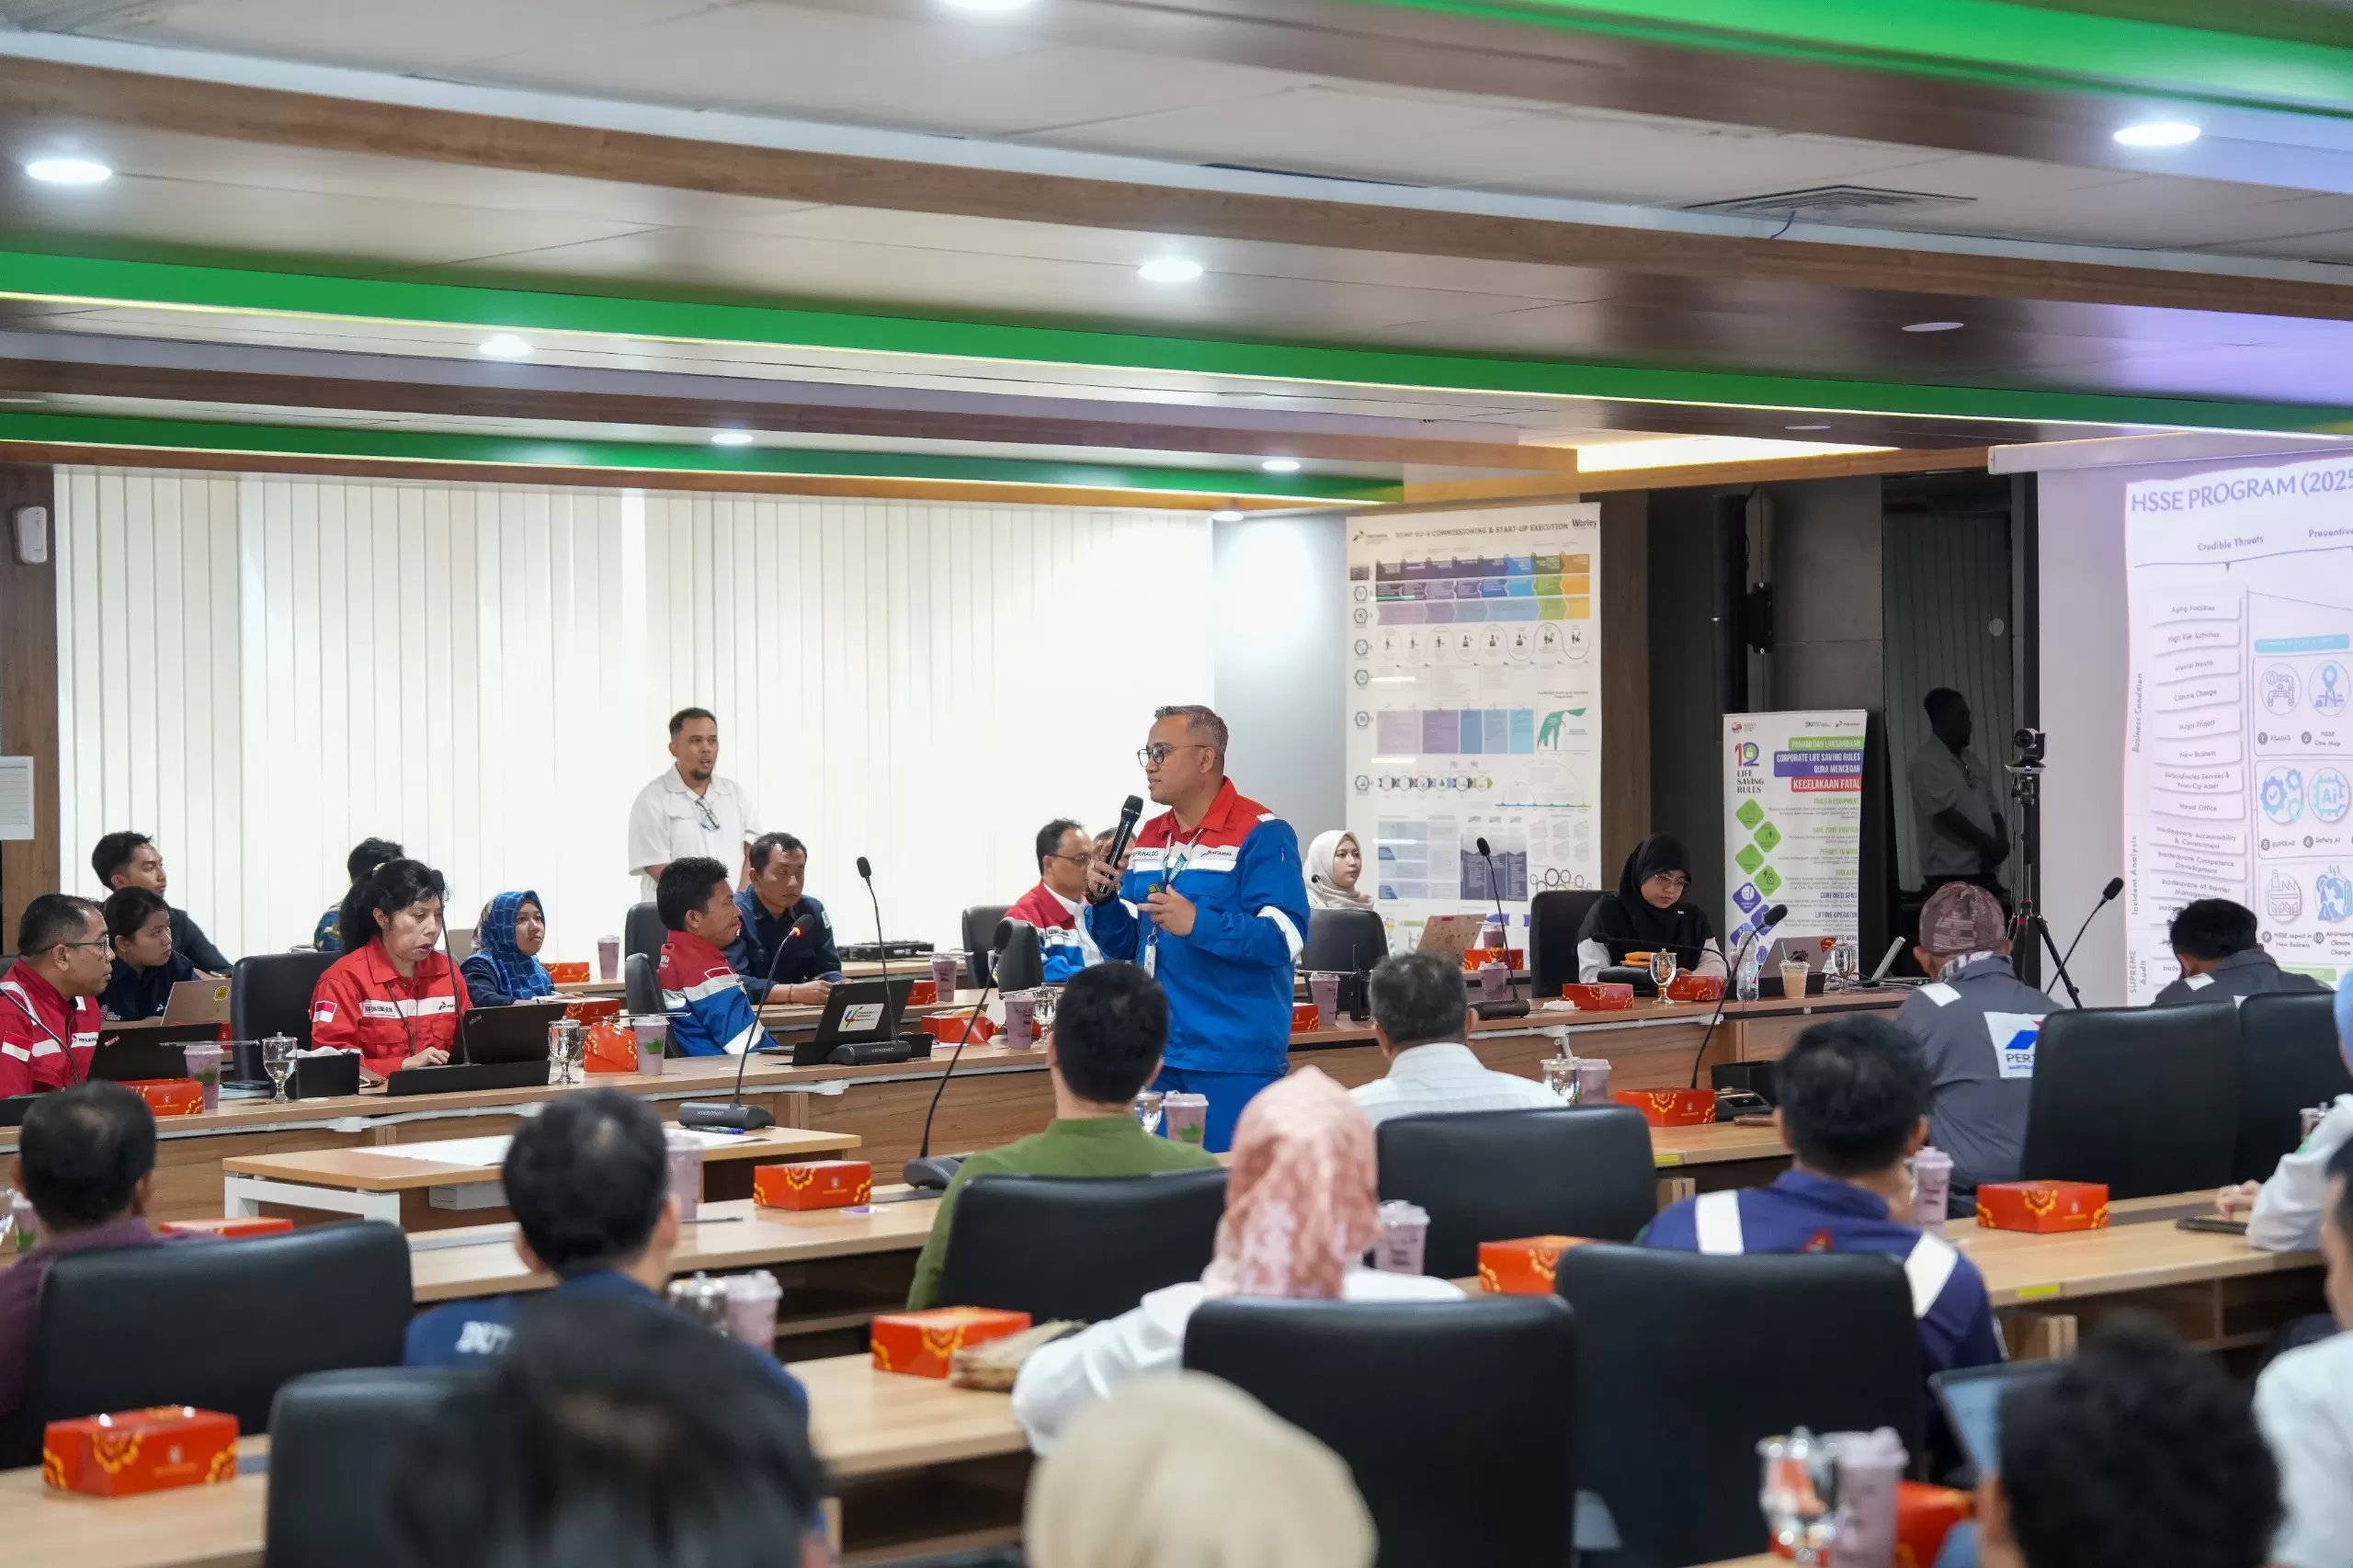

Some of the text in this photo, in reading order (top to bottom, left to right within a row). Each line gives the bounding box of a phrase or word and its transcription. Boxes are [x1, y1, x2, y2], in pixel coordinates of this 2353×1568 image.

[2131, 491, 2184, 512] HSSE
[2188, 474, 2296, 509] PROGRAM
[1495, 524, 1528, 533] START-UP
[1529, 522, 1568, 531] EXECUTION
[1572, 518, 1597, 528] Worley
[2198, 534, 2264, 551] Credible Threats
[2171, 606, 2188, 614] Aging
[2195, 660, 2213, 668] Health
[2134, 673, 2143, 714] Condition
[2195, 689, 2217, 698] Change
[2196, 720, 2215, 728] Project
[1734, 742, 1759, 767] 12
[1777, 752, 1861, 762] CORPORATE LIFE SAVING RULES
[1793, 778, 1860, 790] KECELAKAAN FATAL
[2179, 802, 2197, 811] Head
[2131, 835, 2139, 875] Analysis
